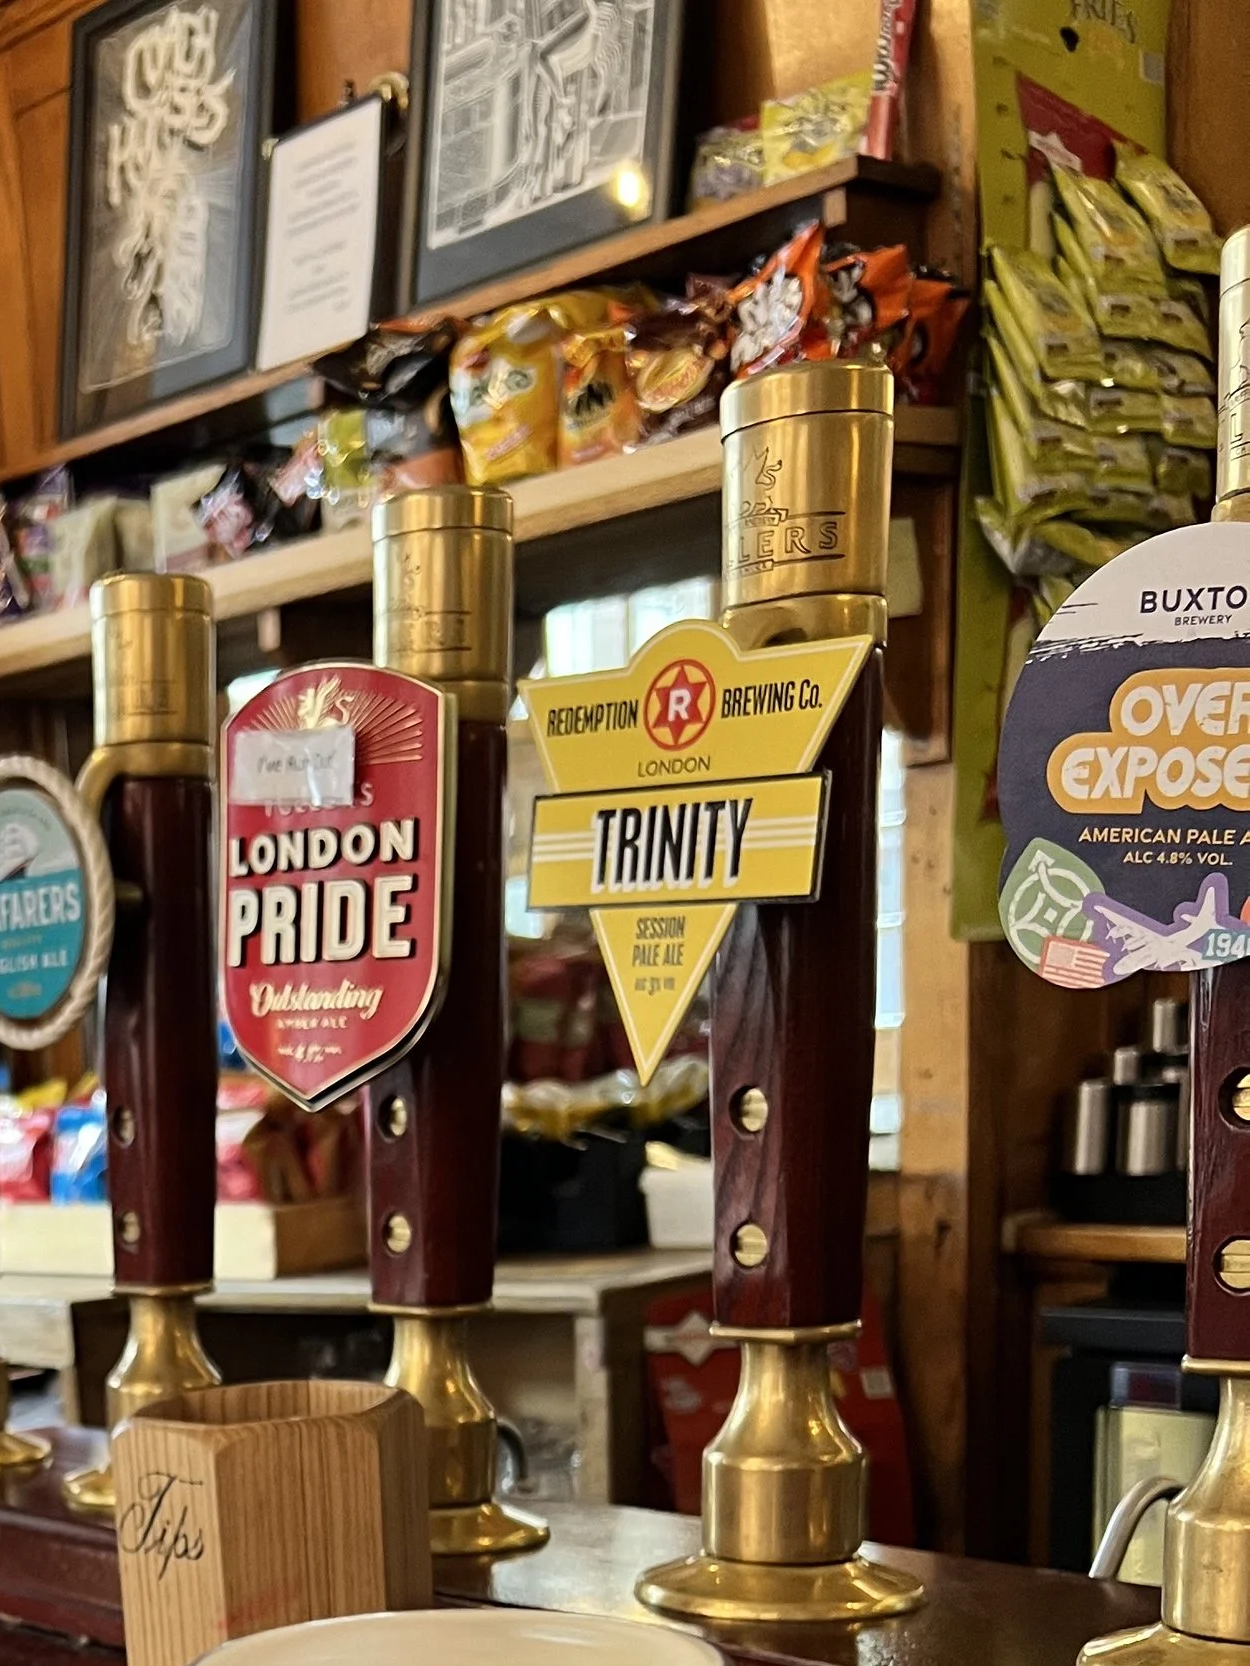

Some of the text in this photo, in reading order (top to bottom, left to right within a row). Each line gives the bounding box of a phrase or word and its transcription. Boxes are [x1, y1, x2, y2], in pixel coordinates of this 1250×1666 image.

[1174, 614, 1233, 627] BREWERY
[667, 688, 693, 723] R
[721, 679, 823, 719] BREWING Co.
[547, 699, 639, 738] REDEMPTION
[637, 755, 711, 778] LONDON
[228, 817, 418, 878] LONDON
[591, 798, 754, 893] TRINITY
[1078, 827, 1181, 844] AMERICAN
[1187, 829, 1237, 845] PALE
[1123, 851, 1233, 866] ALC 4.8% VOL.
[228, 875, 418, 968] PRIDE
[636, 915, 686, 940] SESSION
[632, 943, 684, 968] PALE ALE
[250, 978, 384, 1020] Outstanding
[119, 1471, 204, 1581] Tips
